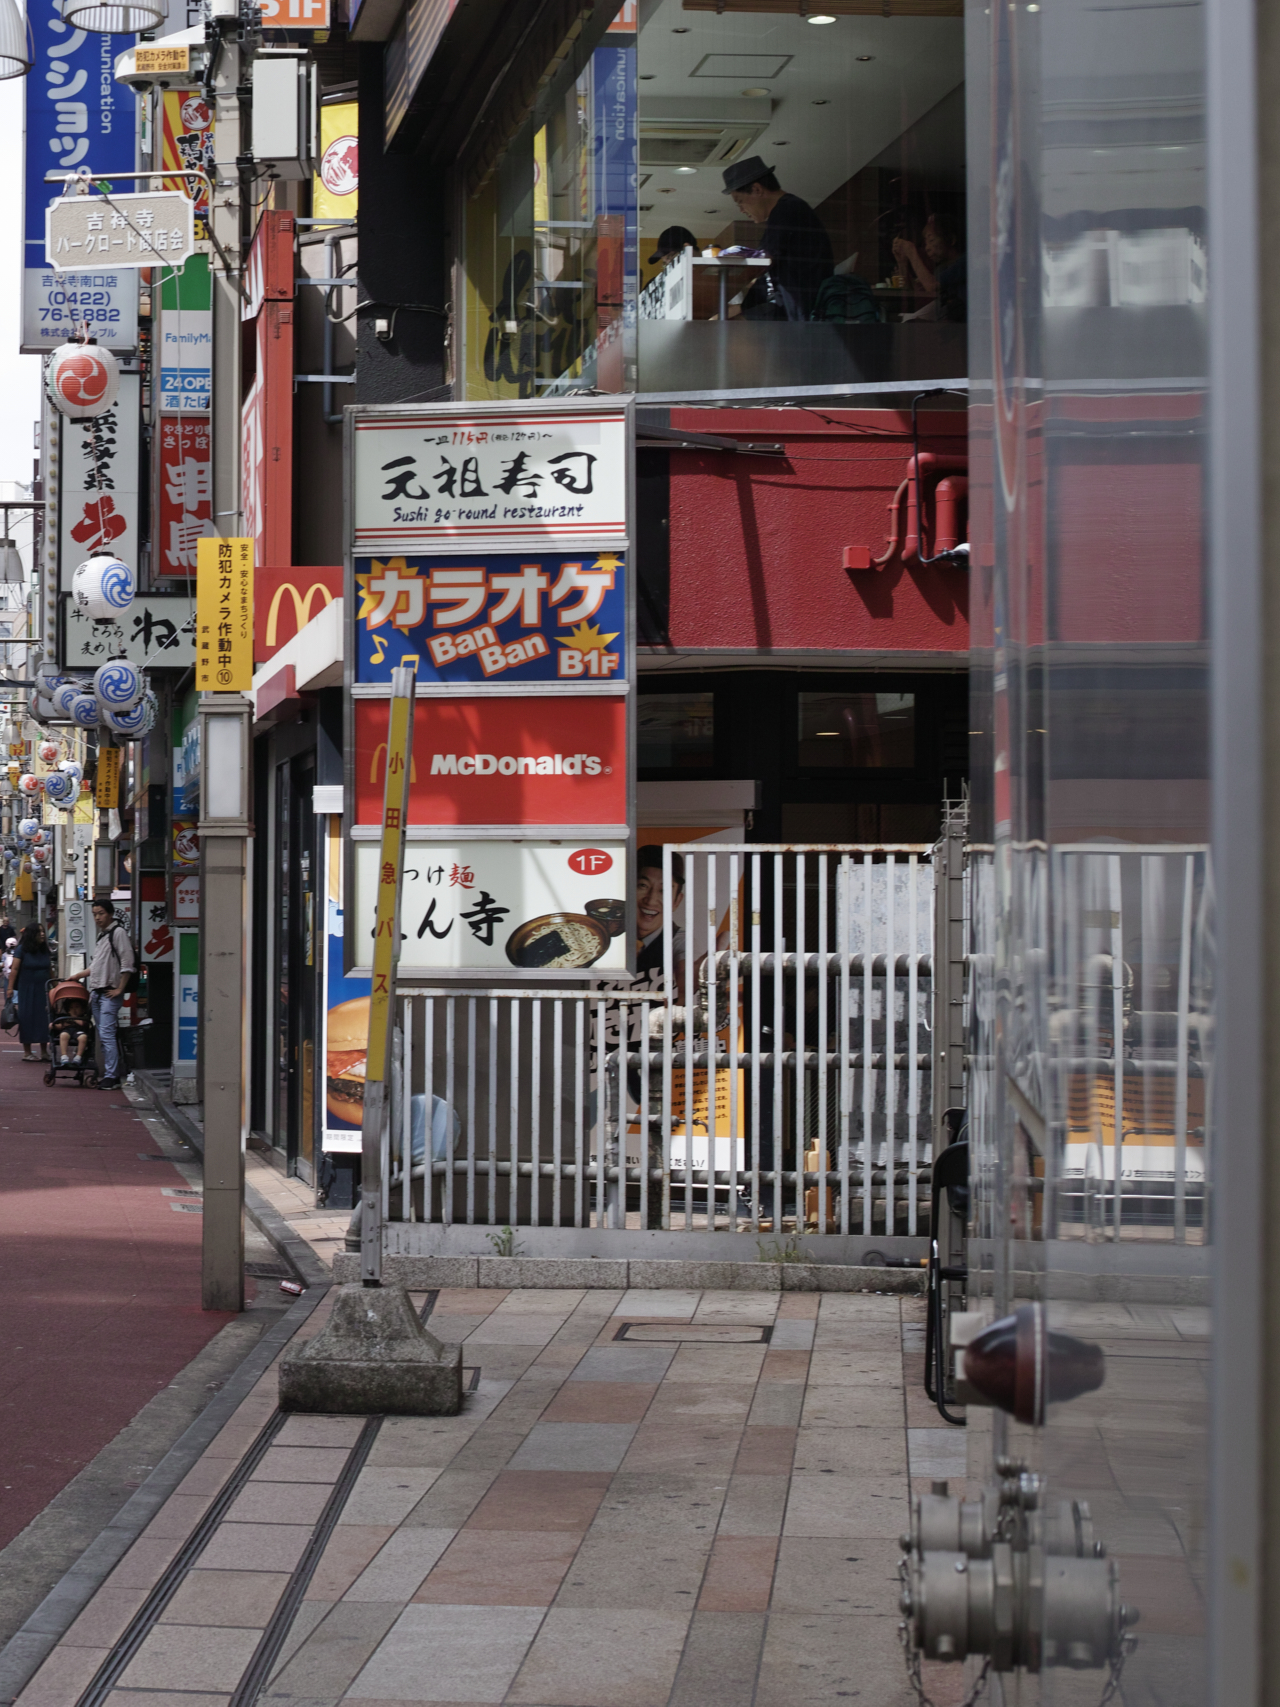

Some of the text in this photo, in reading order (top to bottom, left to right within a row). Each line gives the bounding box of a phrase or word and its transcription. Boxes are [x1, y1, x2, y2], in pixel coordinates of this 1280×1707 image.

[86, 209, 155, 231] 吉祥寺
[57, 227, 185, 254] パークロード商店会
[48, 291, 111, 306] (0422)
[40, 327, 117, 338] 株式会社ップル
[165, 377, 211, 390] 24 OPE
[165, 395, 210, 408] 酒 たば
[80, 401, 119, 490] 浜家系
[163, 436, 209, 449] さっぽ
[381, 451, 598, 501] 元祖寿司
[393, 506, 429, 522] Sushi
[503, 503, 584, 519] restaurant
[240, 544, 249, 639] 安全・安心なまちづくり
[366, 563, 616, 630] カラオケ
[92, 626, 124, 638] とろろ
[81, 641, 117, 655] 麦めし
[201, 626, 210, 682] 武蔵野市
[427, 625, 549, 676] Ban Ban
[558, 648, 619, 678] B1F
[430, 753, 602, 775] McDonald's
[373, 751, 405, 994] 小田急バス
[576, 854, 607, 871] 1F
[403, 862, 476, 889] つけ麺
